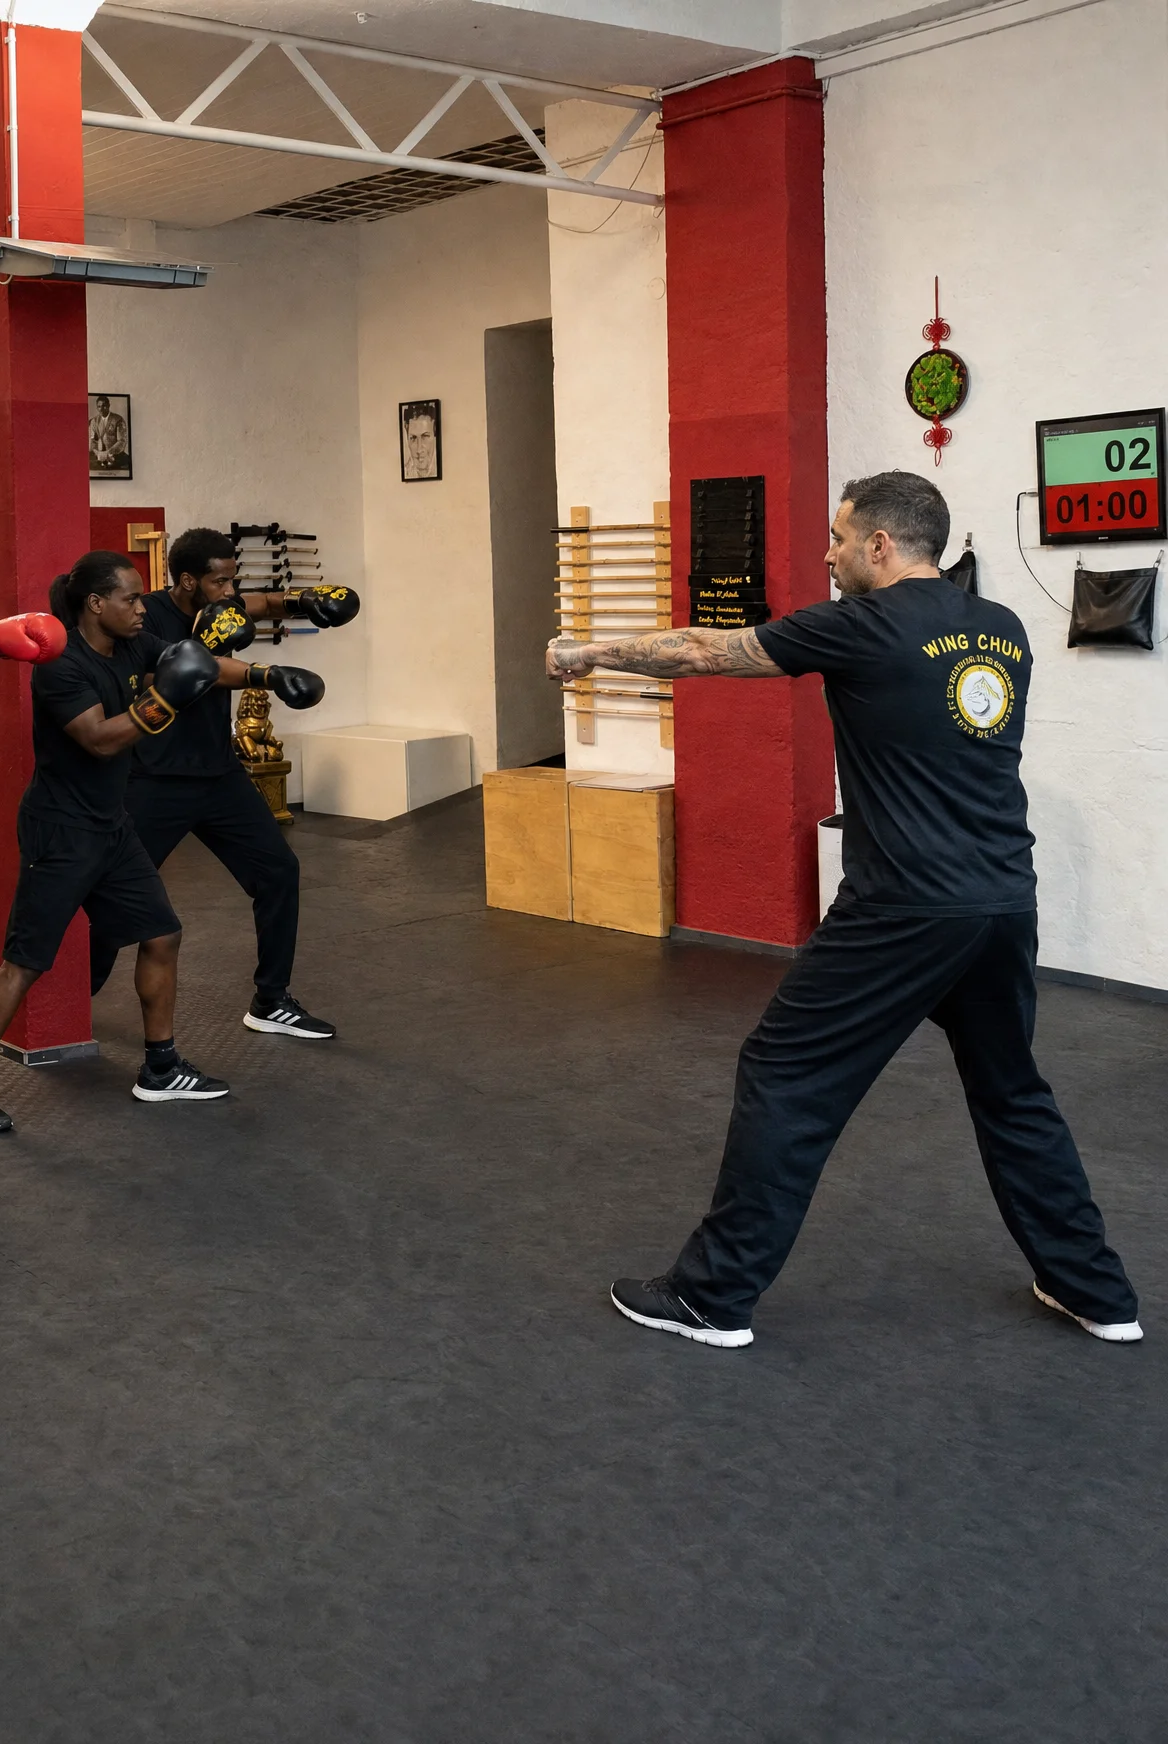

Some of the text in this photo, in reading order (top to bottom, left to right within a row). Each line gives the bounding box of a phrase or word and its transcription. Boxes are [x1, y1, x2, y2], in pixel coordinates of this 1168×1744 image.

[1104, 437, 1151, 473] 02
[1056, 489, 1147, 524] 01:00
[922, 633, 1023, 663] WING CHUN
